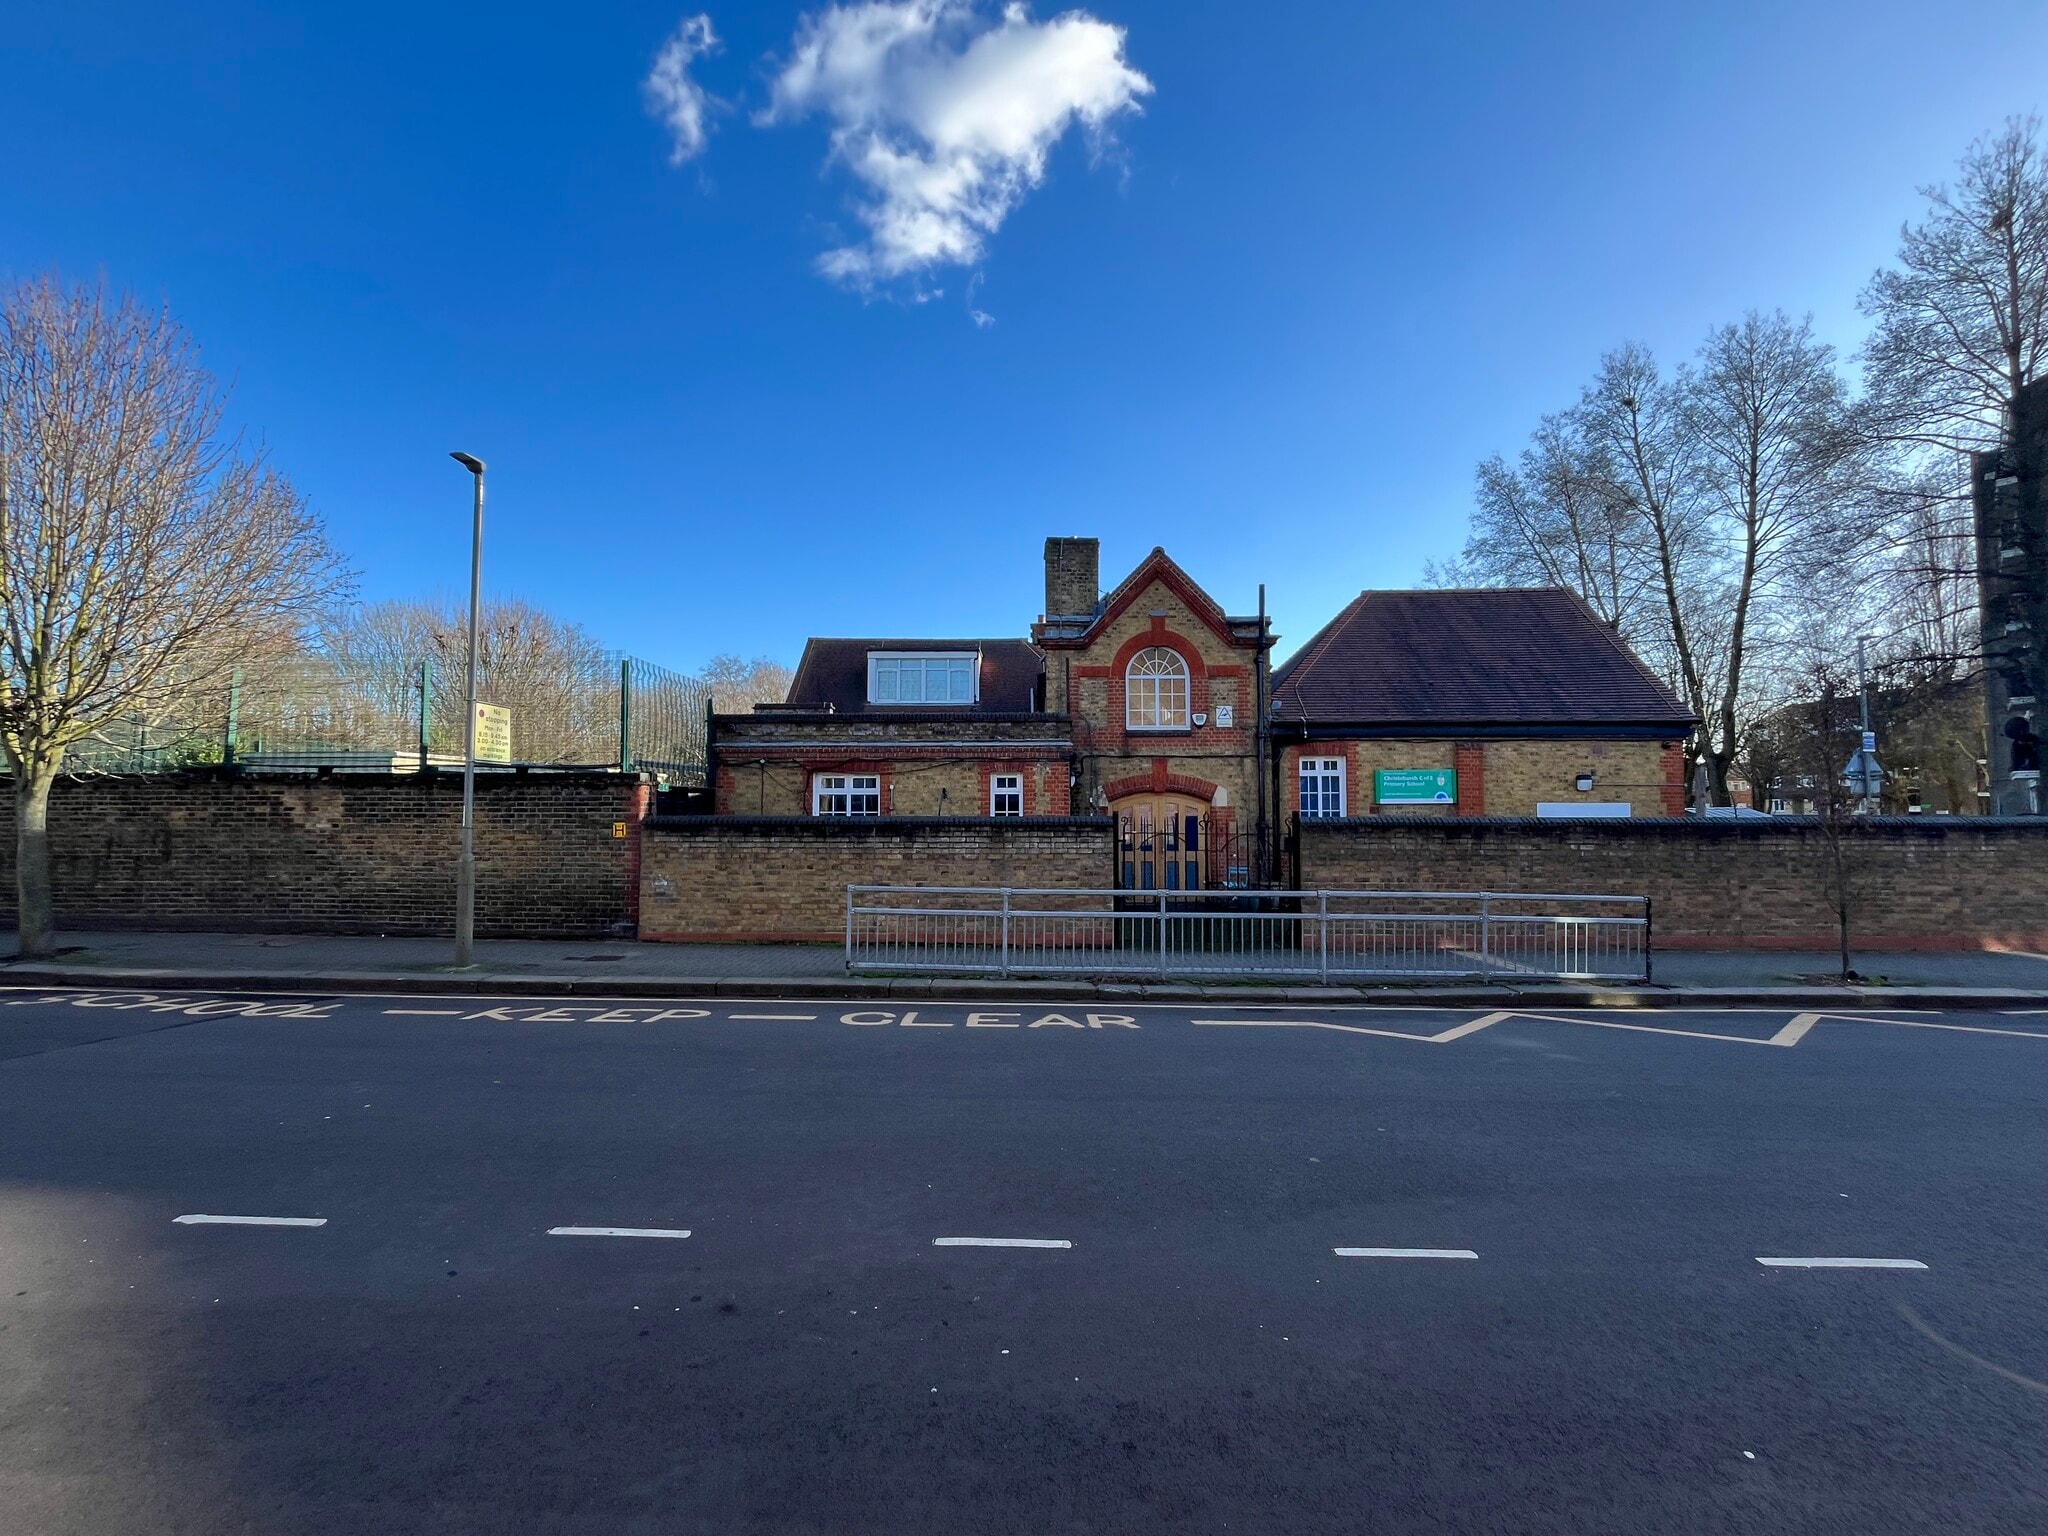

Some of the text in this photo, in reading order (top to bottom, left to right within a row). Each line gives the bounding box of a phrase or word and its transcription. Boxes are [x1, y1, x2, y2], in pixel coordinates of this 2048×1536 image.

[486, 716, 508, 726] stopping
[614, 824, 625, 836] H
[4, 994, 1142, 1029] SCHOOL KEEP CLEAR
